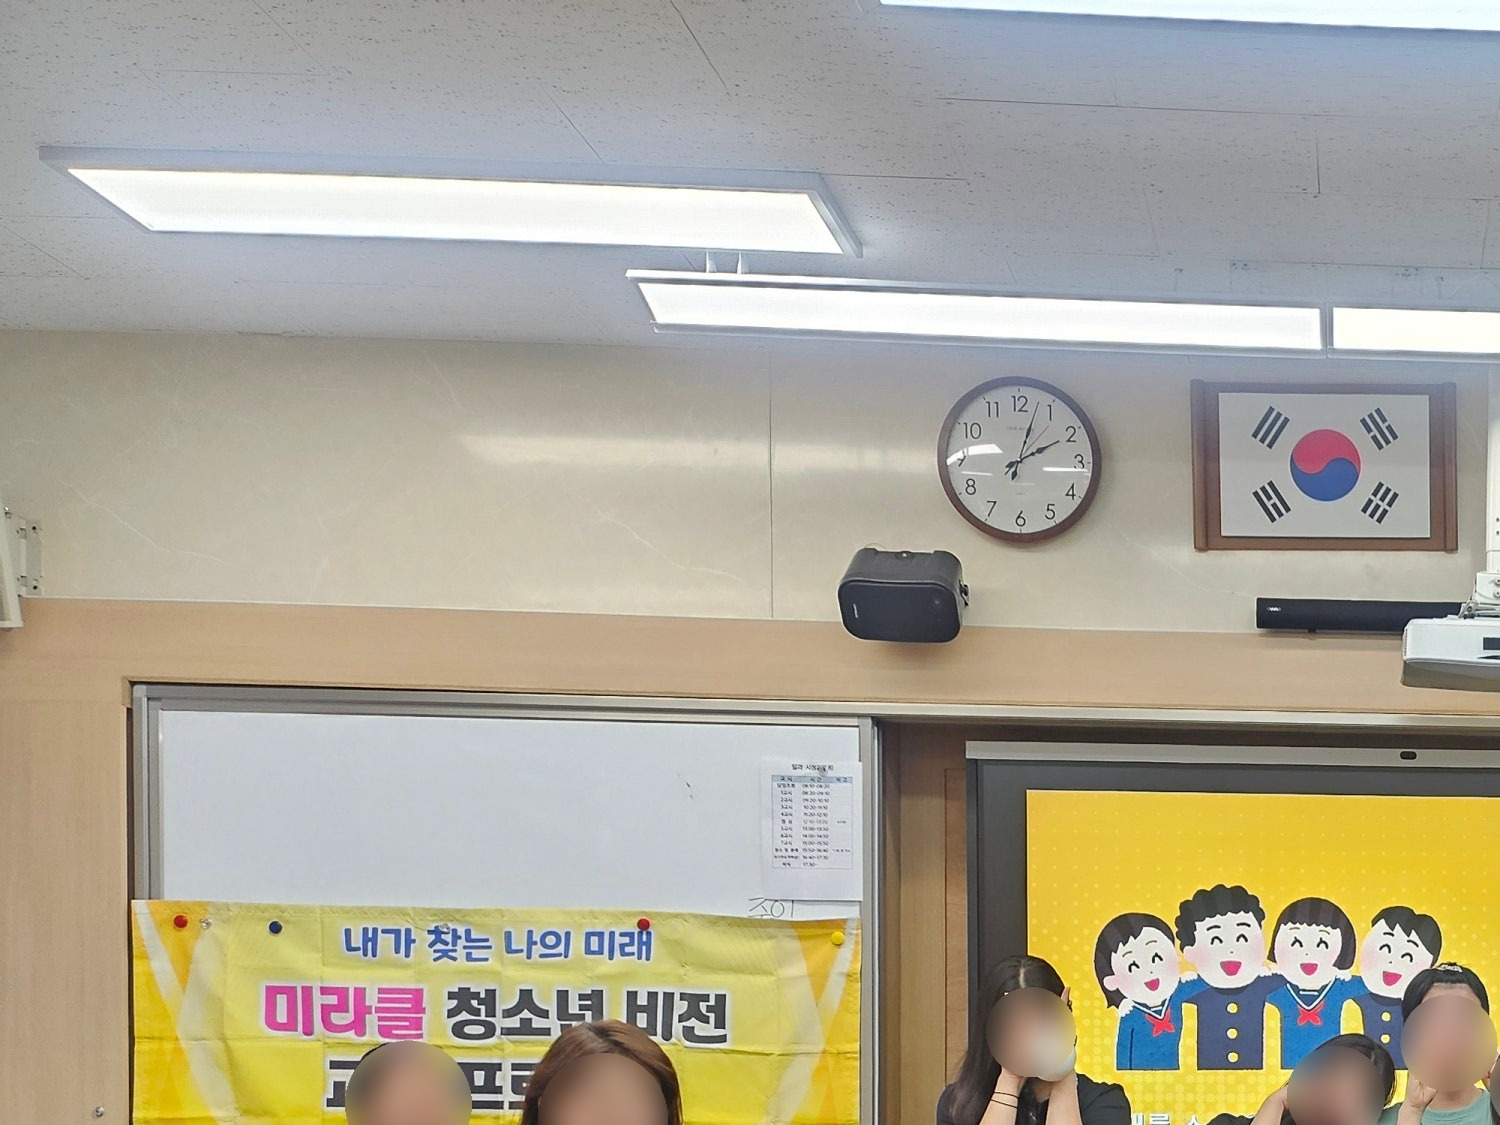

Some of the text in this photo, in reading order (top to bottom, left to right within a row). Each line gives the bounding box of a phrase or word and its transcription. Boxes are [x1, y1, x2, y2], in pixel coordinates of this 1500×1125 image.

[986, 401, 1000, 418] 11
[1011, 395, 1029, 413] 12
[1047, 404, 1053, 421] 1
[963, 422, 982, 440] 10
[1065, 425, 1077, 443] 2
[1073, 453, 1086, 471] 3
[965, 478, 977, 496] 8
[1065, 483, 1077, 501] 4
[986, 500, 997, 518] 7
[1044, 503, 1056, 520] 5
[1015, 510, 1027, 527] 6
[344, 925, 653, 963] 내가 찾는 나의 미래
[264, 984, 729, 1044] 미라클 청소년 비전
